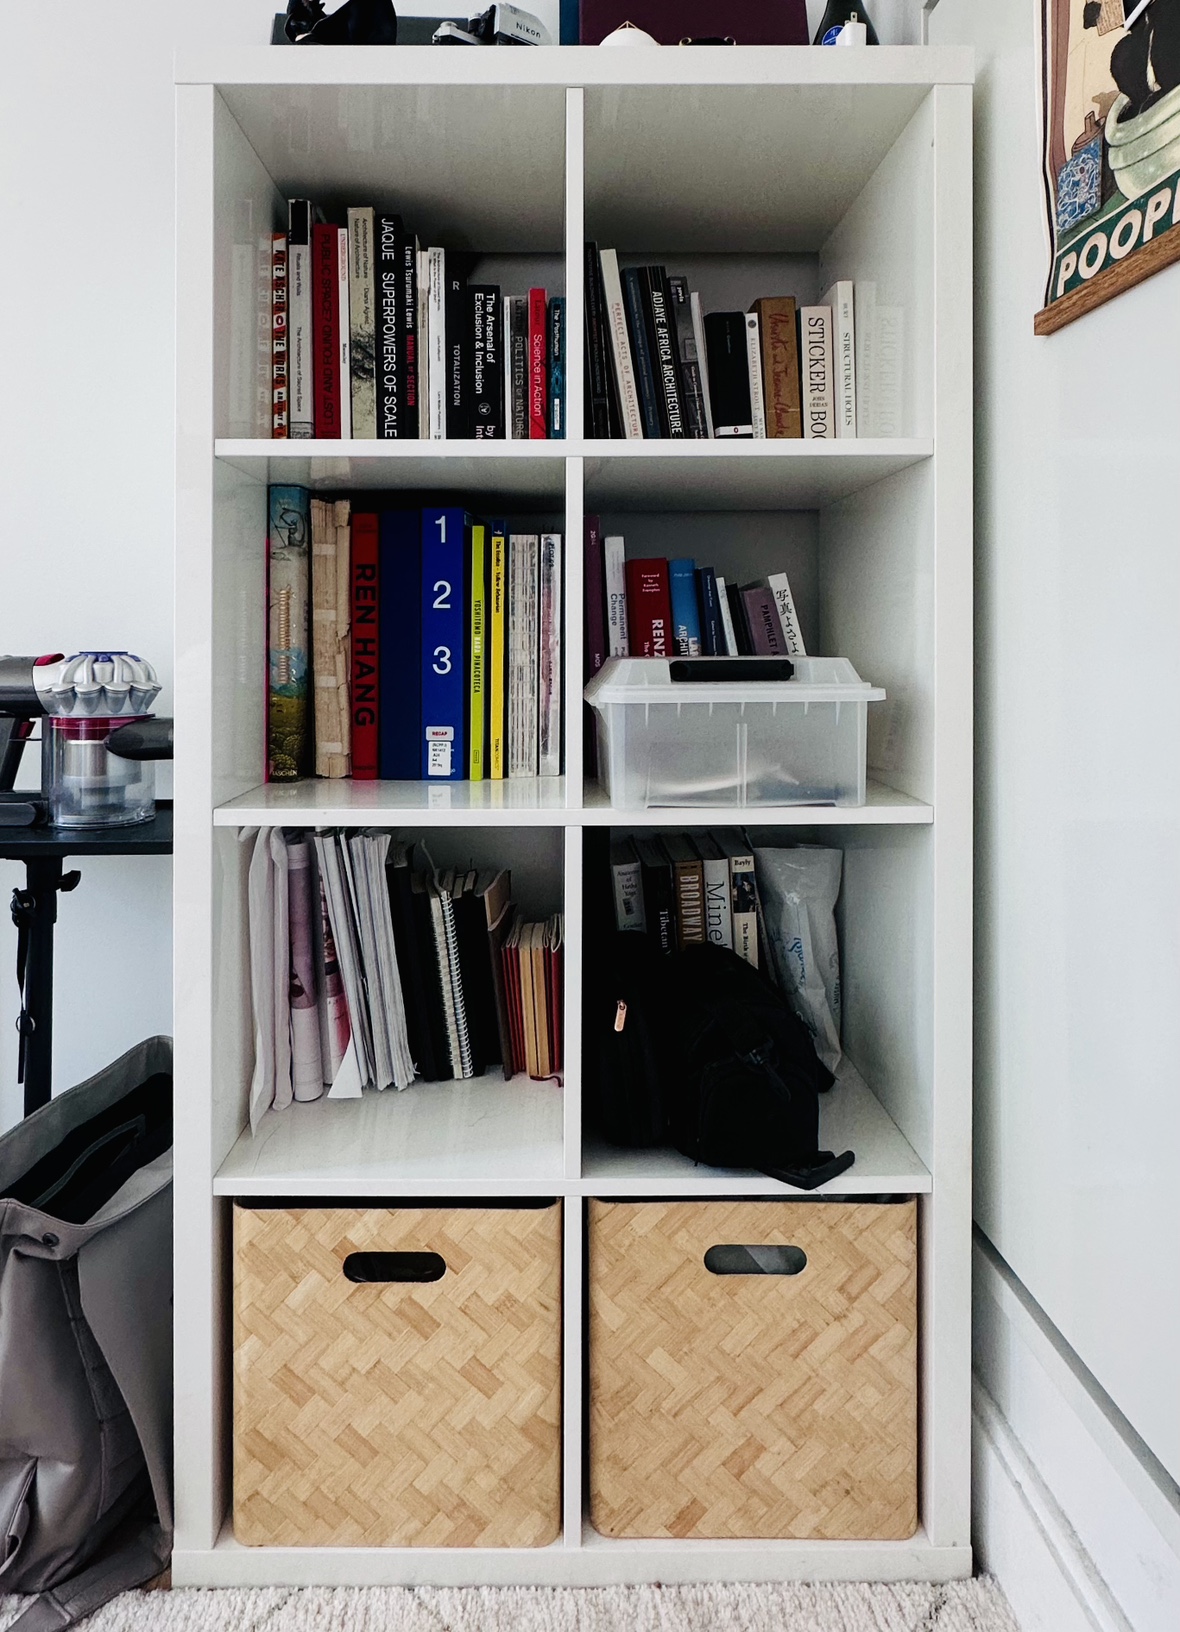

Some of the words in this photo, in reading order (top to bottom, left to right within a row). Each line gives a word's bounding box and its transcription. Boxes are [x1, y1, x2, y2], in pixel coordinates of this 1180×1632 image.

[516, 22, 541, 38] Nikon
[381, 218, 395, 260] JAQUE
[1057, 172, 1180, 297] POOP
[275, 250, 286, 272] KATE
[322, 234, 331, 276] PUBLIC
[405, 246, 413, 266] Lewis
[275, 275, 286, 312] ASCHER
[322, 278, 332, 322] SPACE?
[405, 269, 414, 305] Tsurumaki
[452, 281, 460, 290] R
[406, 308, 414, 328] Lewis
[474, 293, 484, 339] Exclusion
[486, 293, 496, 312] The
[614, 302, 625, 336] PERFECT
[652, 291, 666, 324] ADJAYE
[275, 330, 286, 346] THE
[382, 272, 396, 371] SUPERPOWERS
[486, 315, 496, 351] Arsenal
[322, 325, 333, 365] FOUND
[475, 341, 484, 349] &
[486, 353, 496, 364] of
[515, 336, 524, 385] POLITICS
[533, 334, 543, 373] Science
[620, 341, 628, 360] ACTS
[657, 328, 672, 361] AFRICA
[808, 317, 826, 394] STICKER
[275, 351, 286, 384] WORKS
[475, 352, 484, 394] Inclusion
[624, 365, 630, 374] OF
[843, 332, 852, 393] STRUCTURAL
[322, 368, 334, 393] AND
[384, 375, 396, 392] OF
[407, 375, 415, 406] SECTION
[533, 375, 543, 384] in
[323, 395, 334, 424] LOST
[533, 386, 543, 417] Action
[626, 380, 639, 437] ARCHITECTURE
[662, 365, 682, 433] ARCHITECTURE
[844, 396, 853, 426] HOLES
[384, 396, 398, 437] SCALE
[475, 426, 484, 439] Int
[485, 426, 496, 437] by
[516, 399, 524, 436] NATURE
[811, 410, 827, 438] BO
[434, 515, 446, 543] 1
[355, 564, 376, 624] REN
[432, 581, 451, 608] 2
[618, 593, 627, 640] Permanent
[760, 604, 778, 648] PAMPHLET
[652, 619, 666, 657] RENZ
[677, 625, 688, 656] ARCHIT
[432, 646, 452, 675] 3
[355, 638, 376, 727] HANG
[680, 875, 702, 940] BROADWAY
[706, 881, 728, 947] Mine
[660, 909, 669, 948] Tibetan
